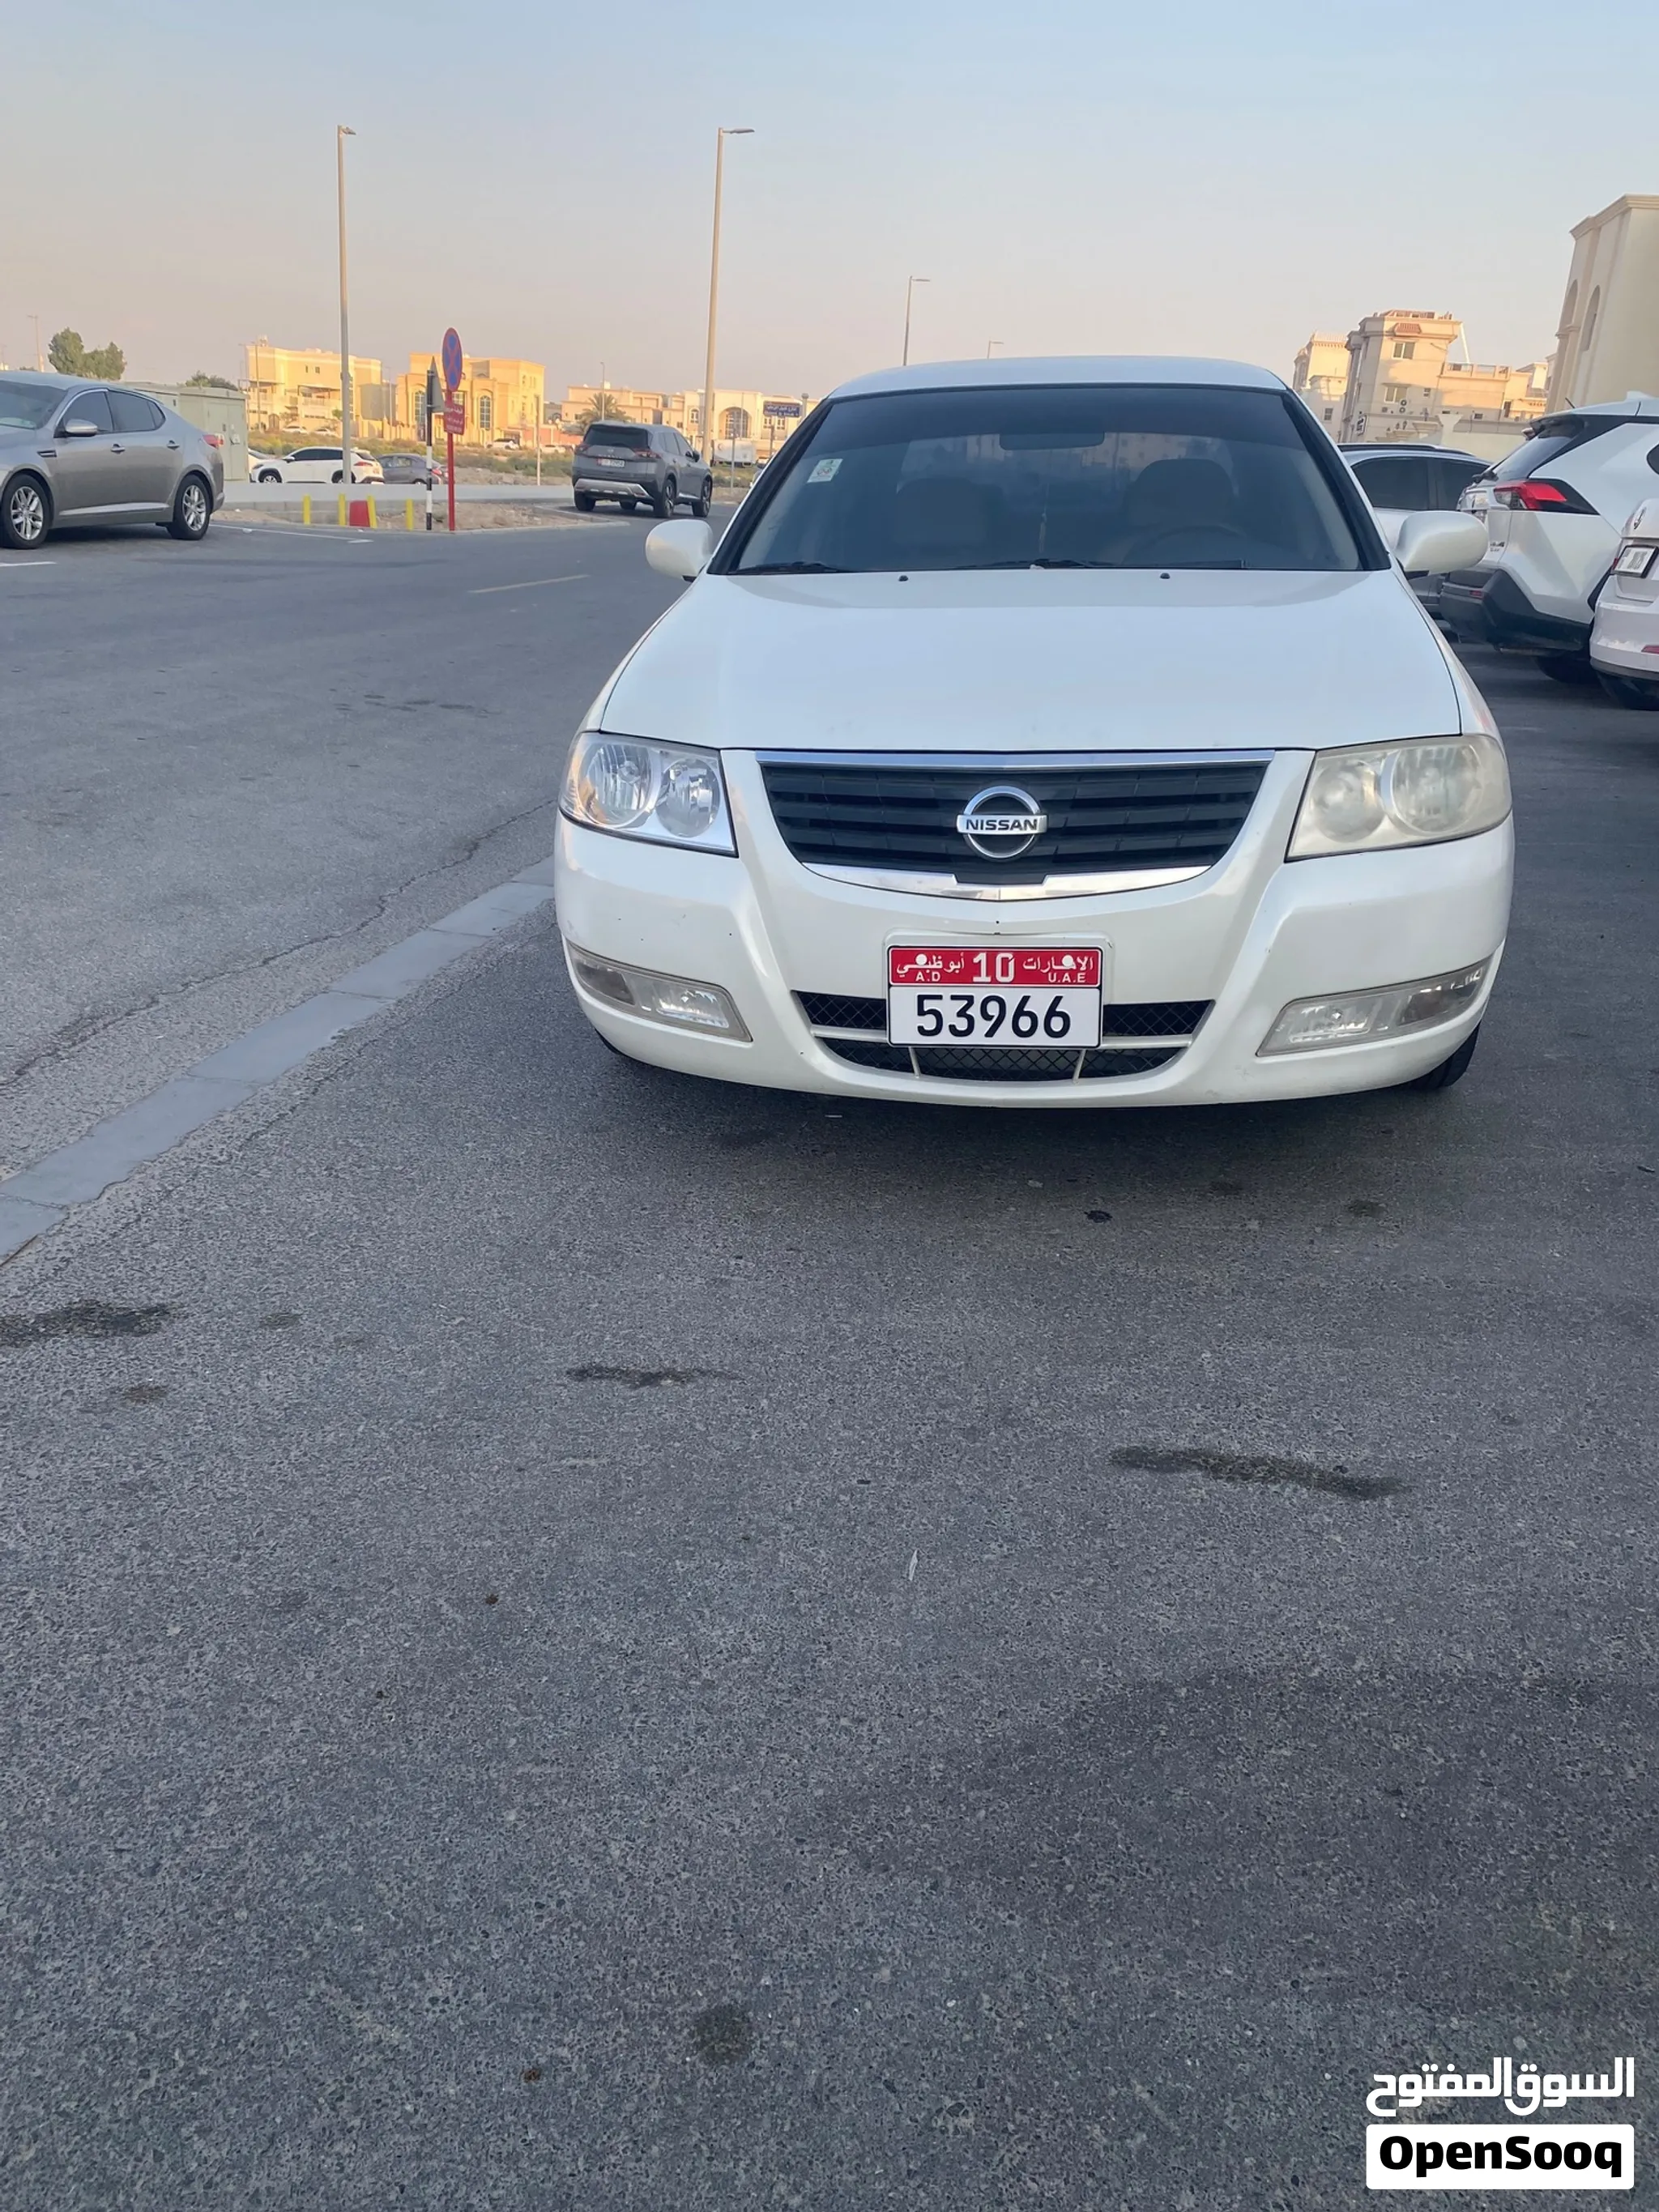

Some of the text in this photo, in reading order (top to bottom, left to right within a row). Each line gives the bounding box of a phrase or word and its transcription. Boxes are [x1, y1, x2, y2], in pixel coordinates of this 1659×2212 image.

[966, 819, 1038, 831] NISSAN
[896, 952, 965, 978] أبو ظبي
[972, 952, 1015, 983] 10
[1048, 972, 1086, 982] U.A.E
[916, 994, 1072, 1038] 53966
